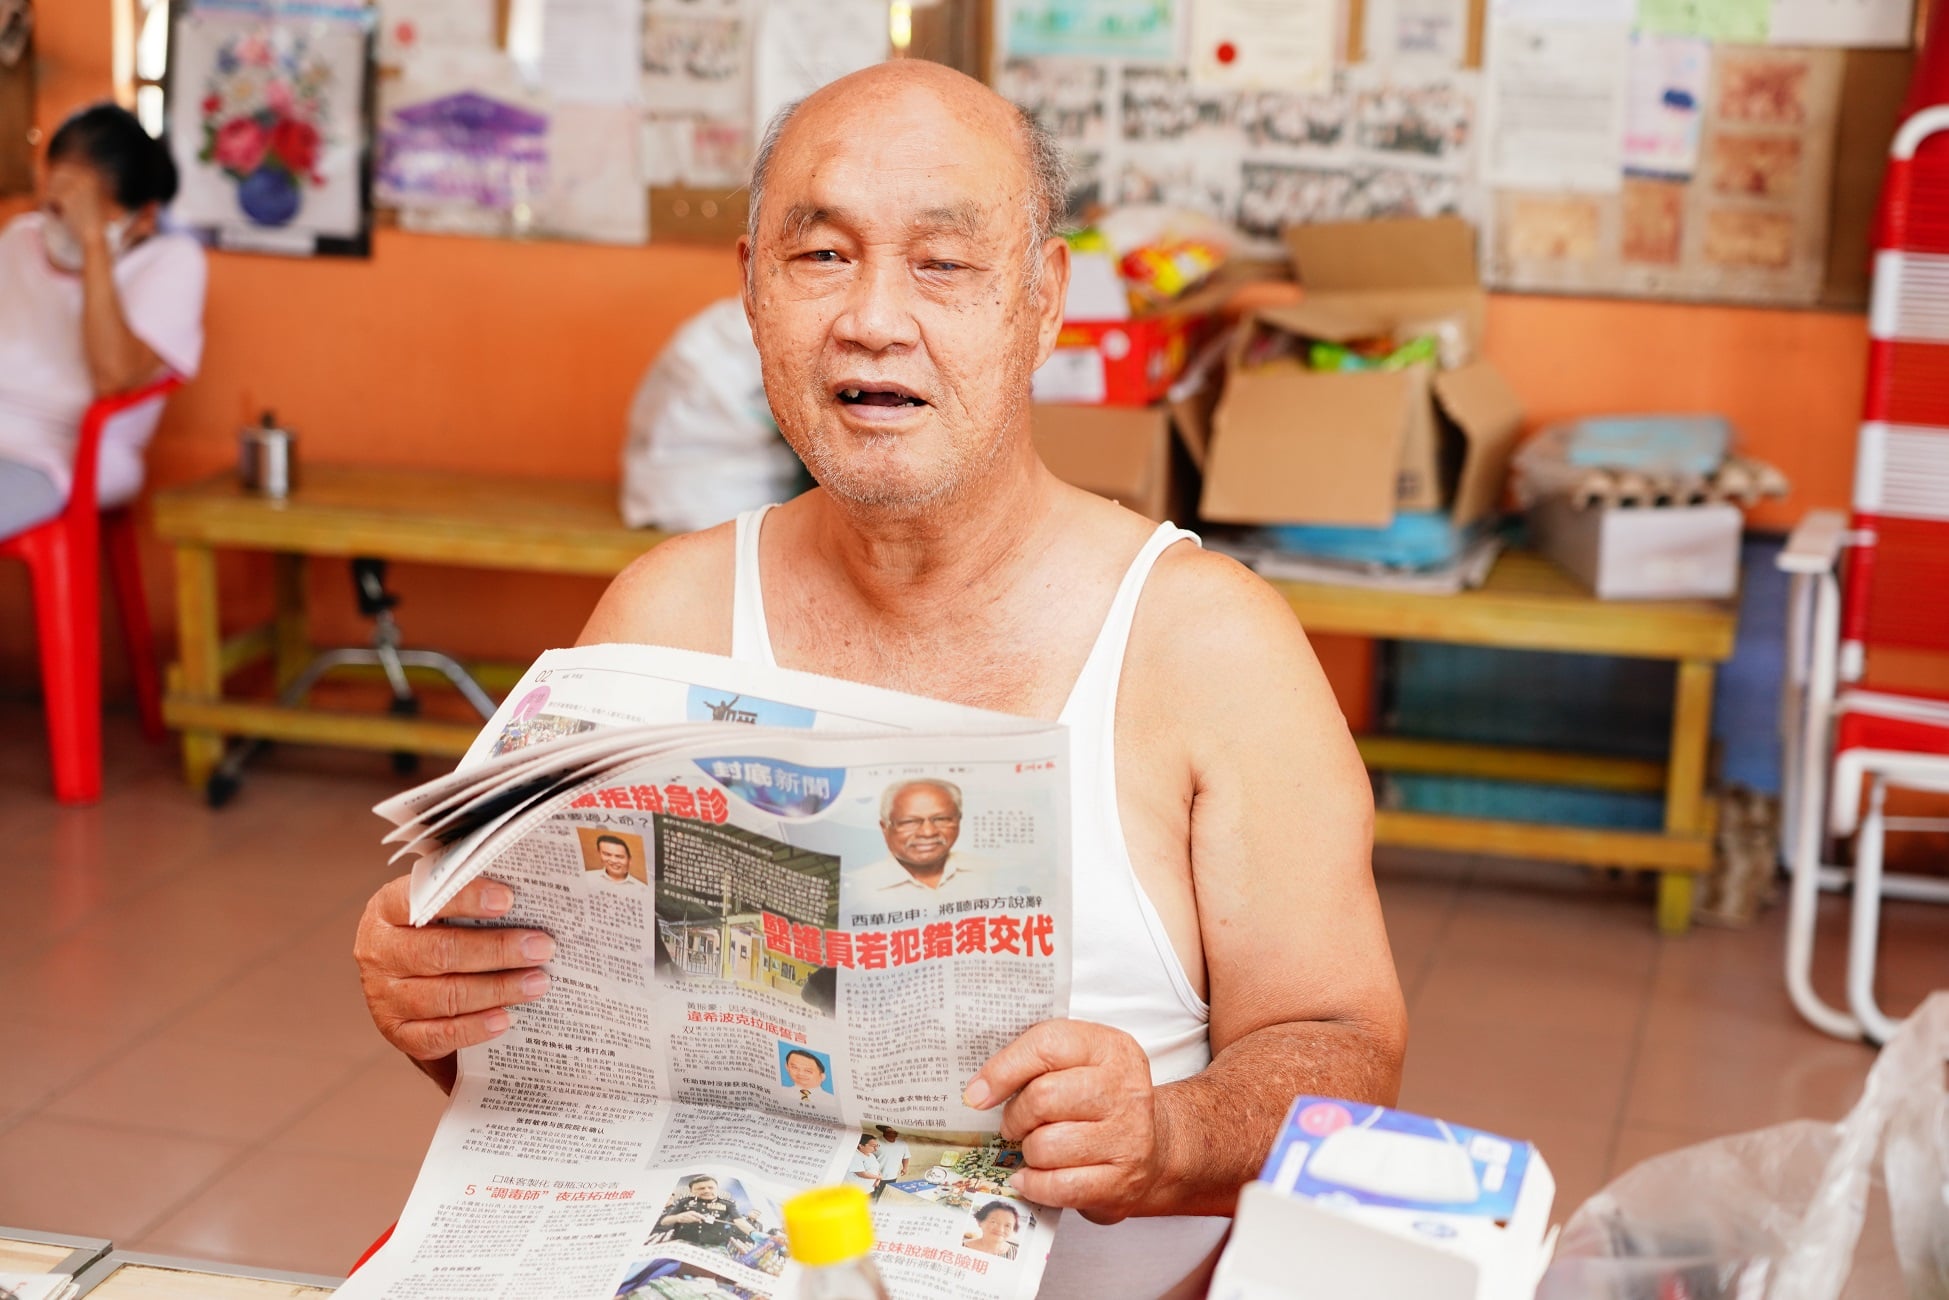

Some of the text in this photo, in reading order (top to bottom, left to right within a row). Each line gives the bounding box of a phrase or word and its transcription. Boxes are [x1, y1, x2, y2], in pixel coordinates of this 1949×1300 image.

[534, 669, 553, 683] 02
[711, 760, 831, 800] 封底新聞
[761, 911, 1055, 971] 醫護員若犯錯須交代
[687, 1010, 808, 1045] 違希波克拉底誓言
[464, 1184, 477, 1196] 5
